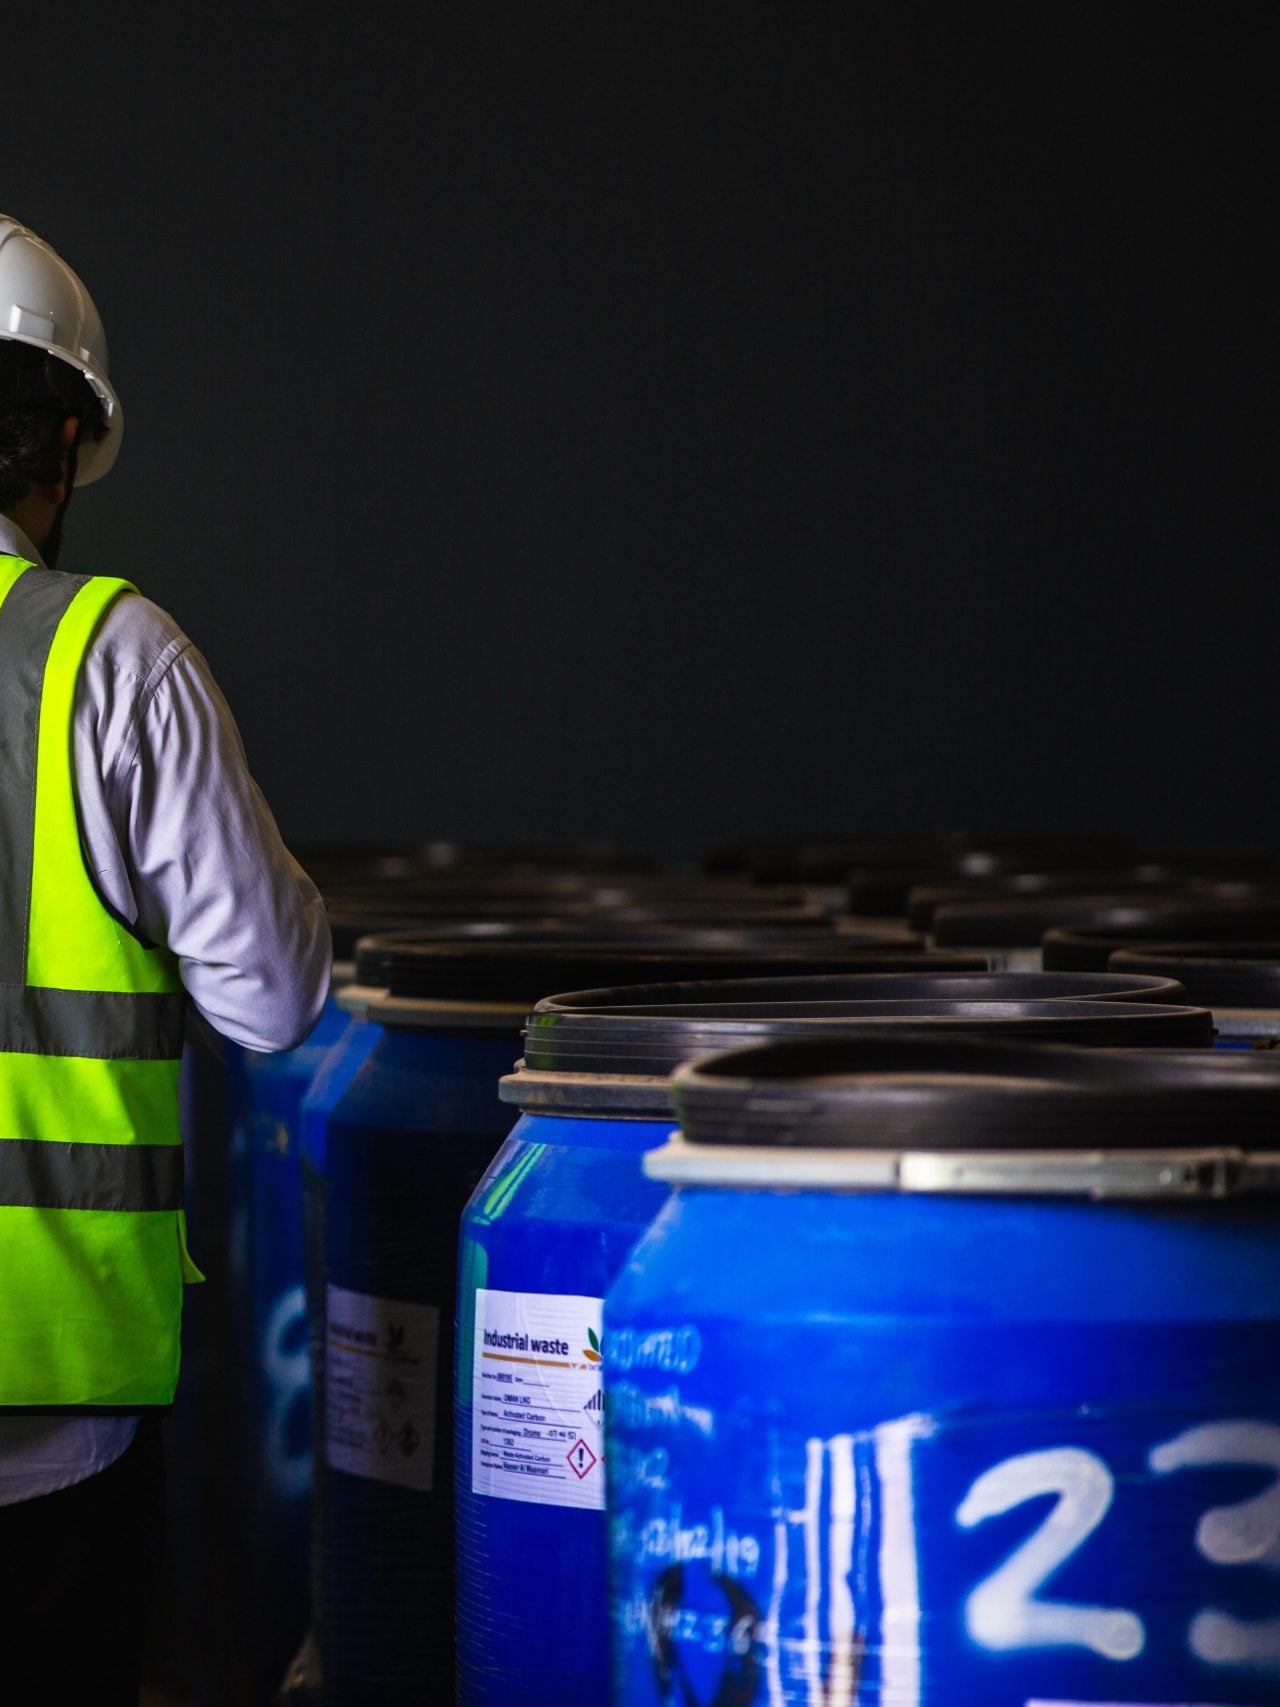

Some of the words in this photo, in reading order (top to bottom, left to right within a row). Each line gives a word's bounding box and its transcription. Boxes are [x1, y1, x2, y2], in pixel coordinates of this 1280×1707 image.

[483, 1328, 528, 1351] Industrial
[531, 1339, 569, 1356] waste
[526, 1412, 547, 1422] Carbon
